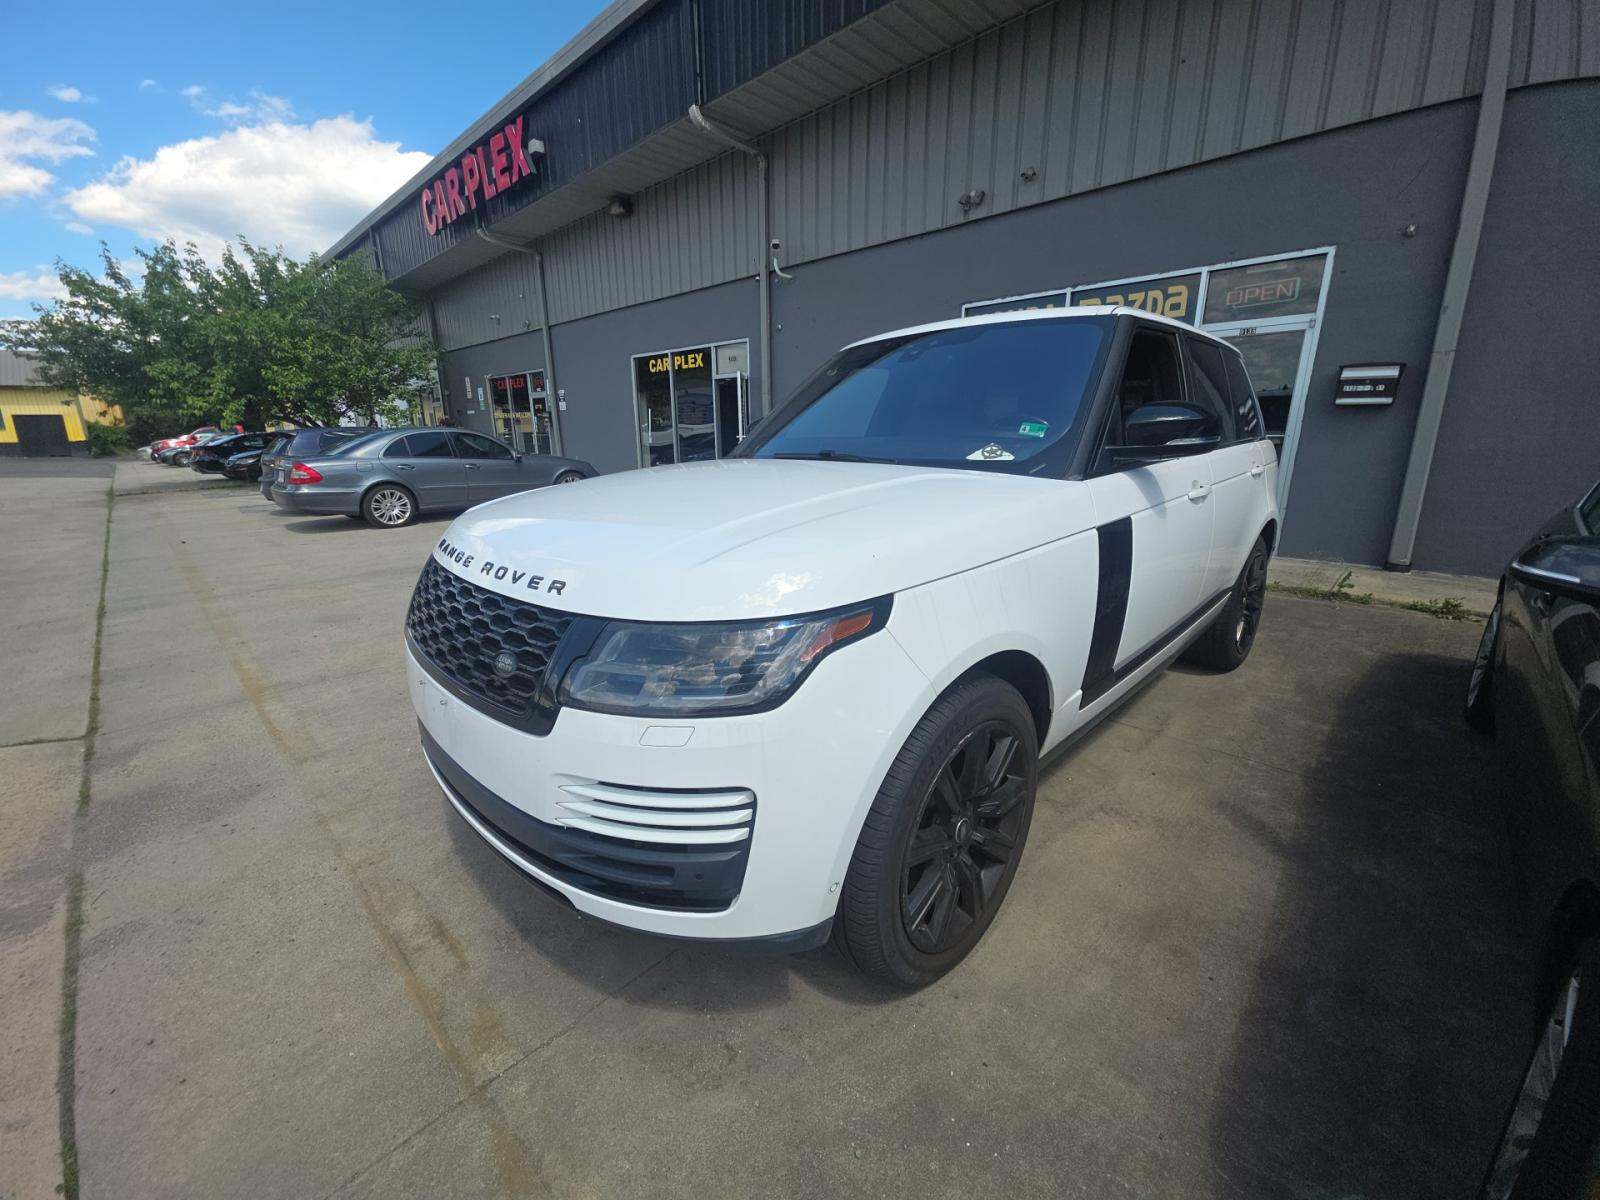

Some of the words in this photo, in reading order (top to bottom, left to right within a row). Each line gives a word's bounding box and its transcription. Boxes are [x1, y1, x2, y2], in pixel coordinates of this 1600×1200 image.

[1225, 281, 1294, 306] OPEN
[649, 358, 670, 373] CAR
[674, 352, 704, 370] PLEX
[438, 538, 475, 568] RANGE
[481, 561, 567, 596] ROVER
